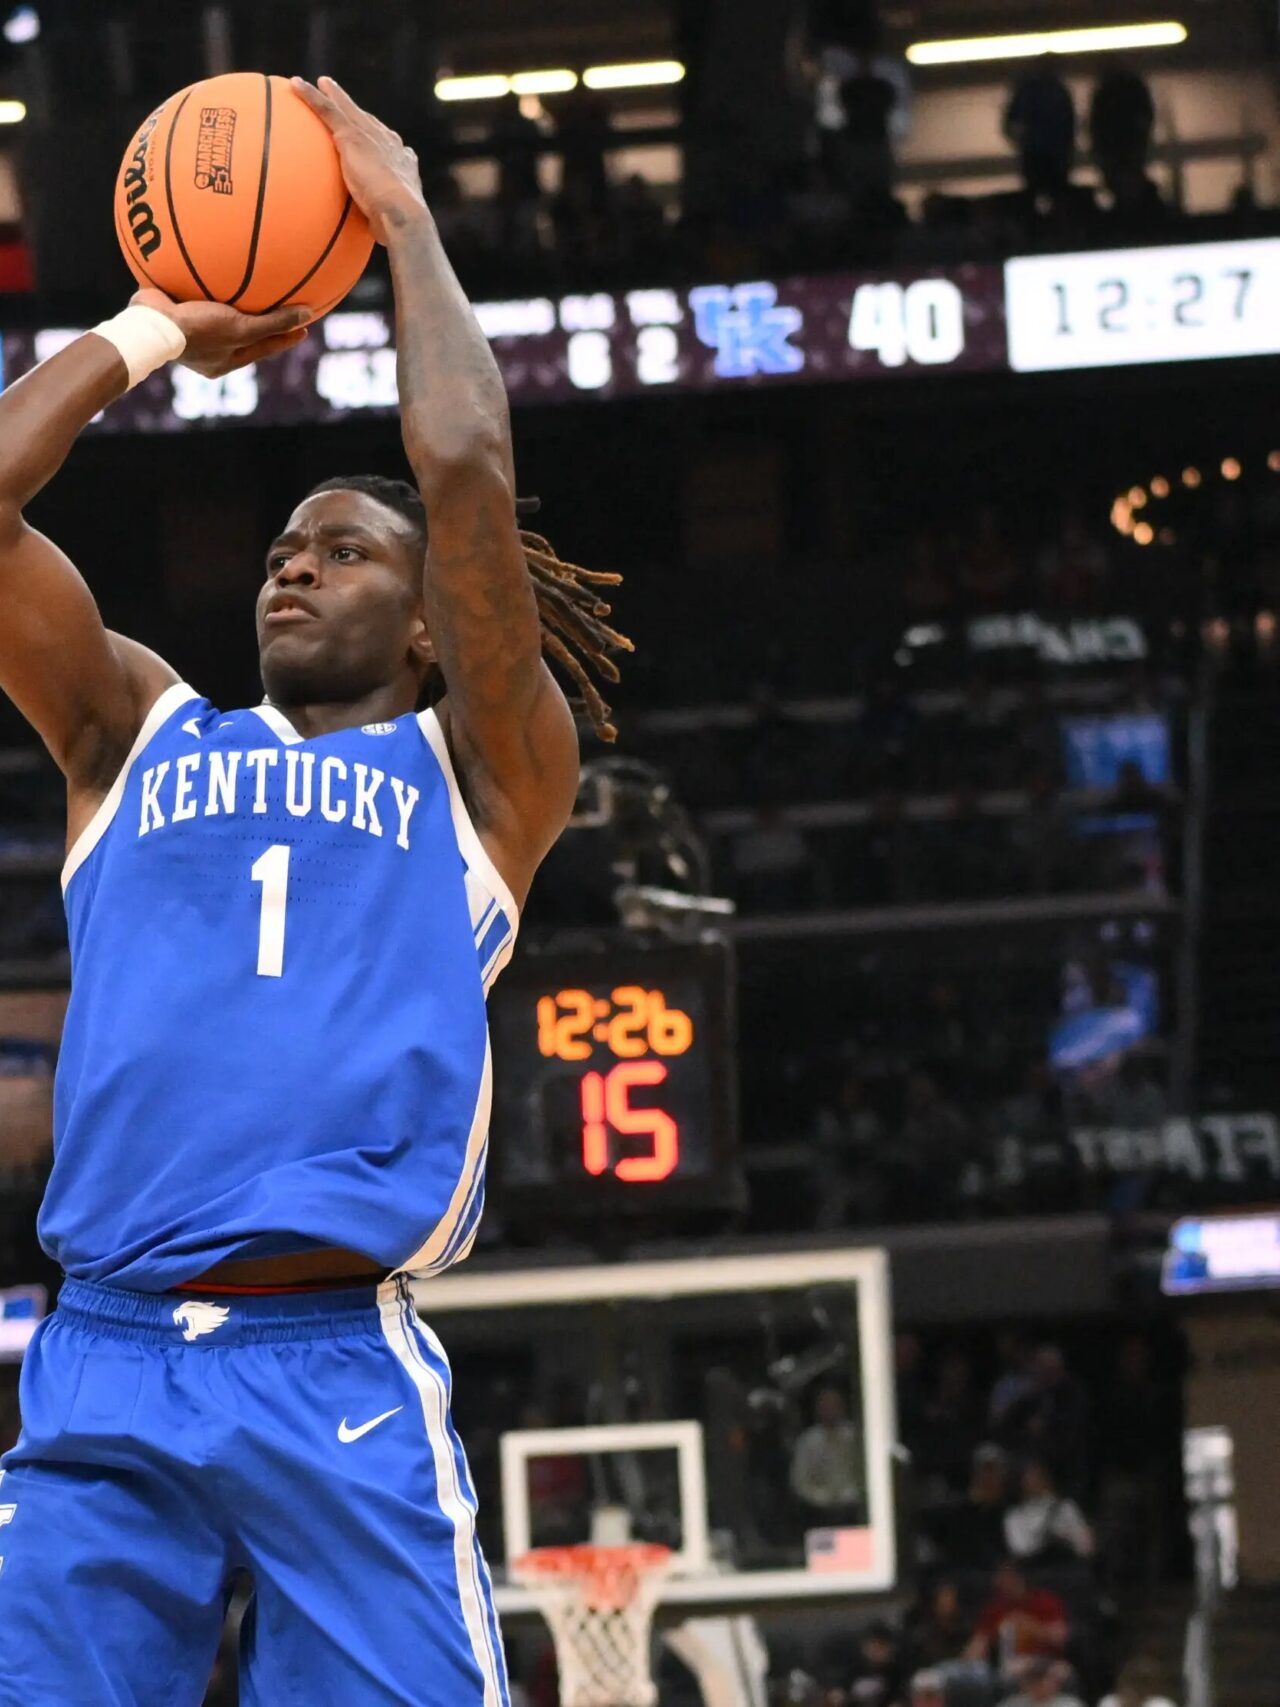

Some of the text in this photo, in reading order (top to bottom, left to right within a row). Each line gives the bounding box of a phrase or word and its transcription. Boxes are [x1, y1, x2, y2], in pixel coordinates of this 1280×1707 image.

[849, 279, 964, 367] 40
[1051, 268, 1256, 337] 12:27
[138, 748, 420, 850] KENTUCKY
[250, 844, 291, 977] 1
[537, 986, 693, 1061] 12:26
[581, 1060, 678, 1181] 15
